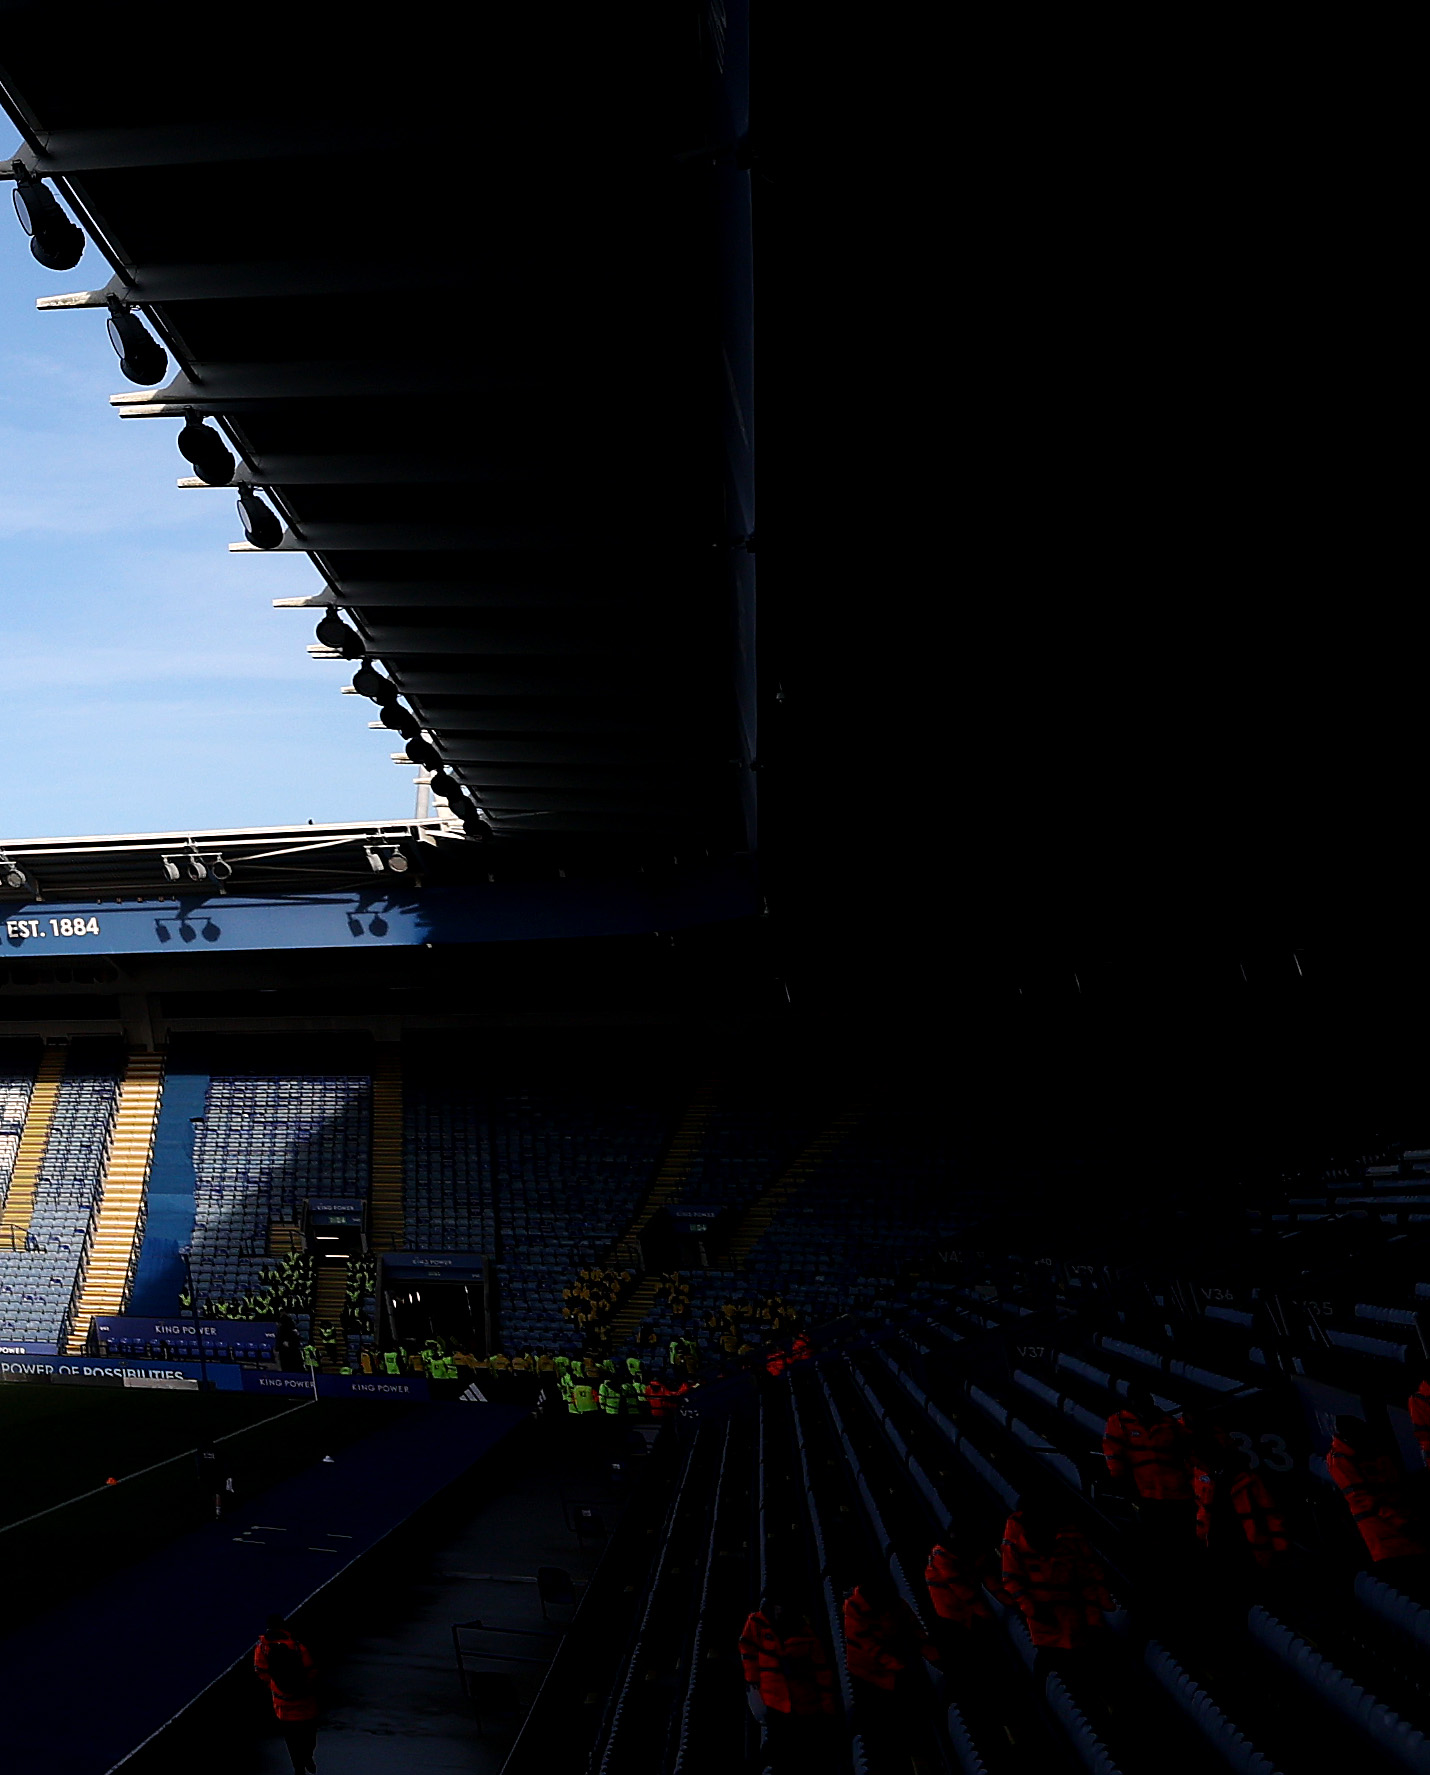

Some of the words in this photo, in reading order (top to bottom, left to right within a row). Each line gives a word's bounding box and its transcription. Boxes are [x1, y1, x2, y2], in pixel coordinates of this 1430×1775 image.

[6, 919, 46, 939] EST.
[49, 916, 100, 937] 1884
[155, 1325, 180, 1335] KING
[1015, 1344, 1045, 1359] V37
[1, 1362, 53, 1377] POWER
[82, 1366, 184, 1381] POSSIBILITIES
[259, 1378, 282, 1388] KING
[284, 1379, 315, 1389] POWER
[352, 1383, 375, 1392] KING
[376, 1384, 411, 1394] POWER
